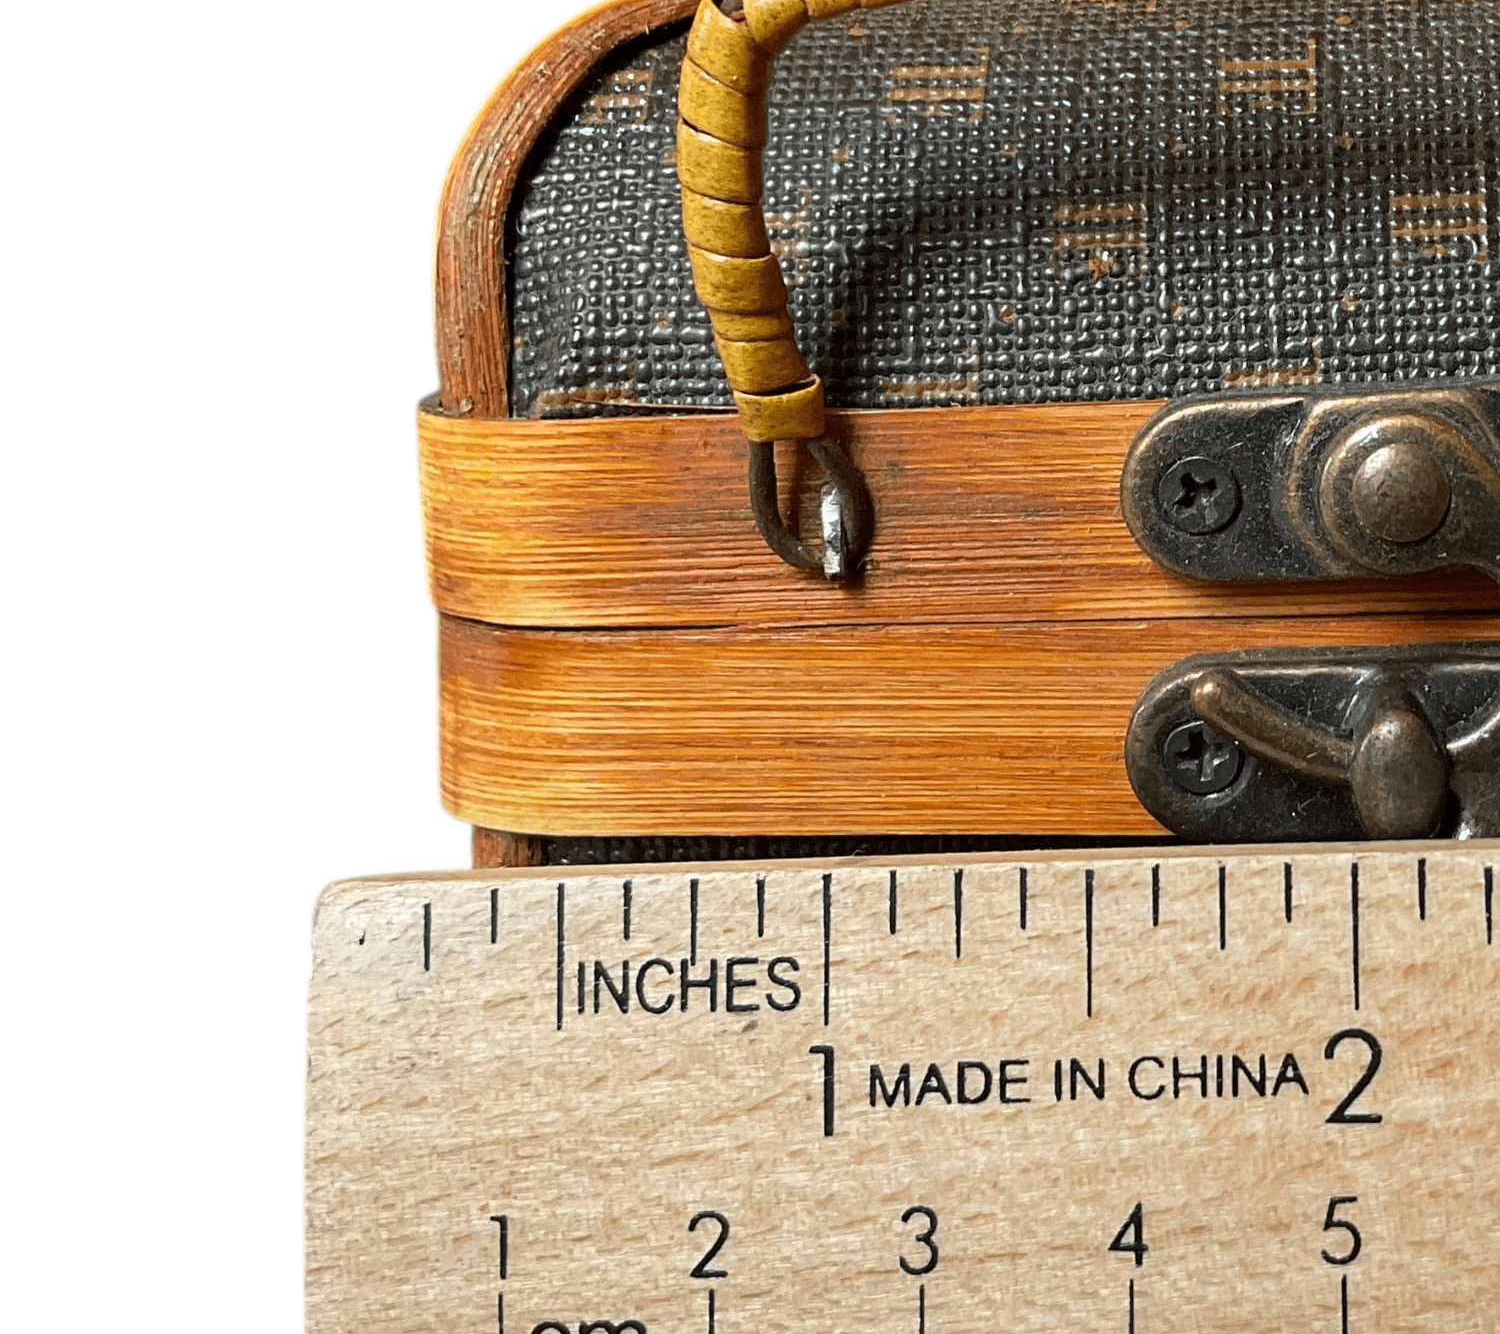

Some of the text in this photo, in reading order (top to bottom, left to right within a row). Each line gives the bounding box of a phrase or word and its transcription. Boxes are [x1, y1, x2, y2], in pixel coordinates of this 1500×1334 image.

[577, 958, 801, 1015] INCHES
[808, 1045, 835, 1137] 1
[868, 1053, 1310, 1108] MADE IN CHINA
[1324, 1028, 1383, 1124] 2
[489, 1214, 508, 1280] 1
[687, 1210, 730, 1279] 2
[899, 1205, 939, 1276] 3
[1107, 1201, 1149, 1268] 4
[1320, 1196, 1362, 1266] 5
